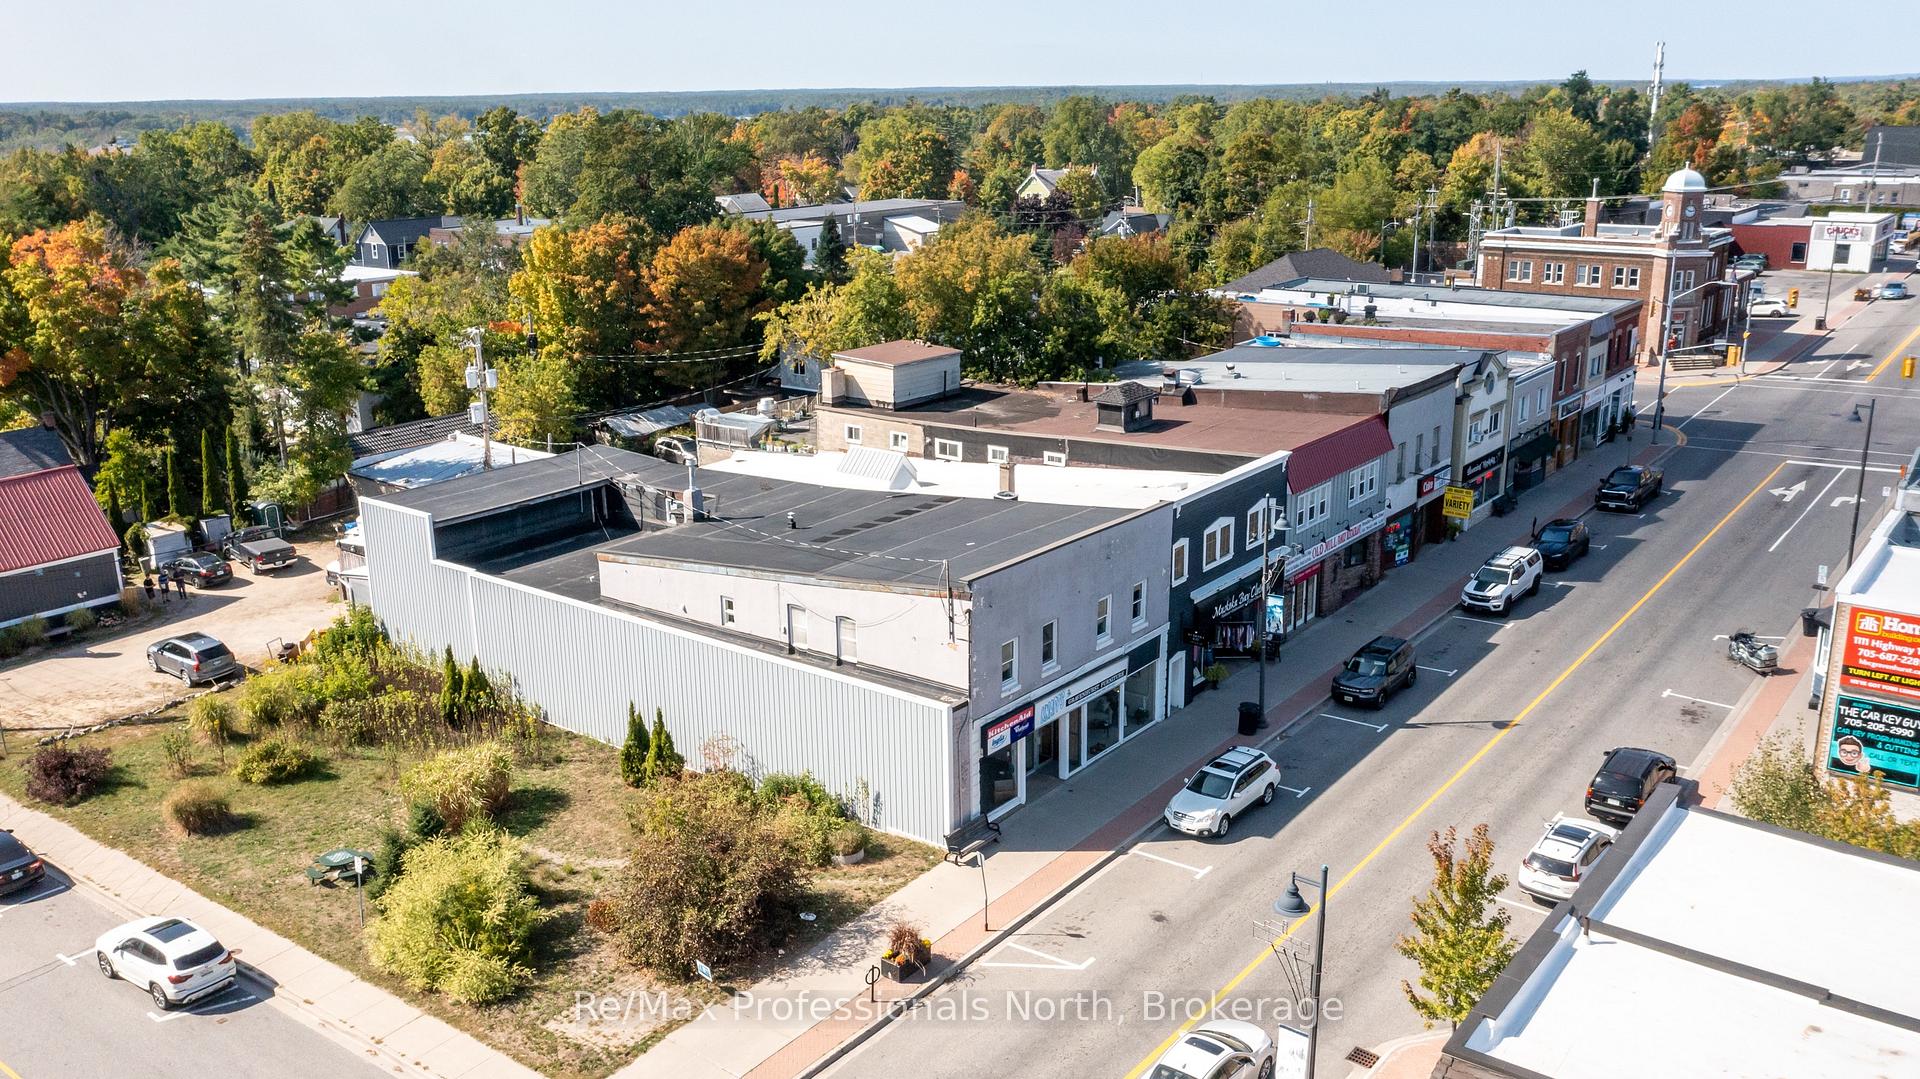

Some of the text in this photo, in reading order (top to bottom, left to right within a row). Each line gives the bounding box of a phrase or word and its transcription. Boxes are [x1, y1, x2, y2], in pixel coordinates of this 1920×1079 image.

[1445, 497, 1471, 511] VARIETY
[1311, 542, 1324, 560] OLD
[1871, 639, 1916, 656] Highway
[1848, 667, 1871, 678] TURN
[1872, 671, 1889, 681] LEFT
[1890, 675, 1901, 683] AT
[1838, 705, 1860, 718] THE
[1860, 709, 1881, 722] CAR
[1882, 713, 1902, 725] KEY
[988, 711, 1031, 738] KitchenAid
[1844, 717, 1915, 738] 705-205-2990
[1836, 726, 1920, 748] CAR KEY PROGRAMMING
[1876, 741, 1919, 756] & CUTTING
[1868, 751, 1919, 768] CALL OR TEXT
